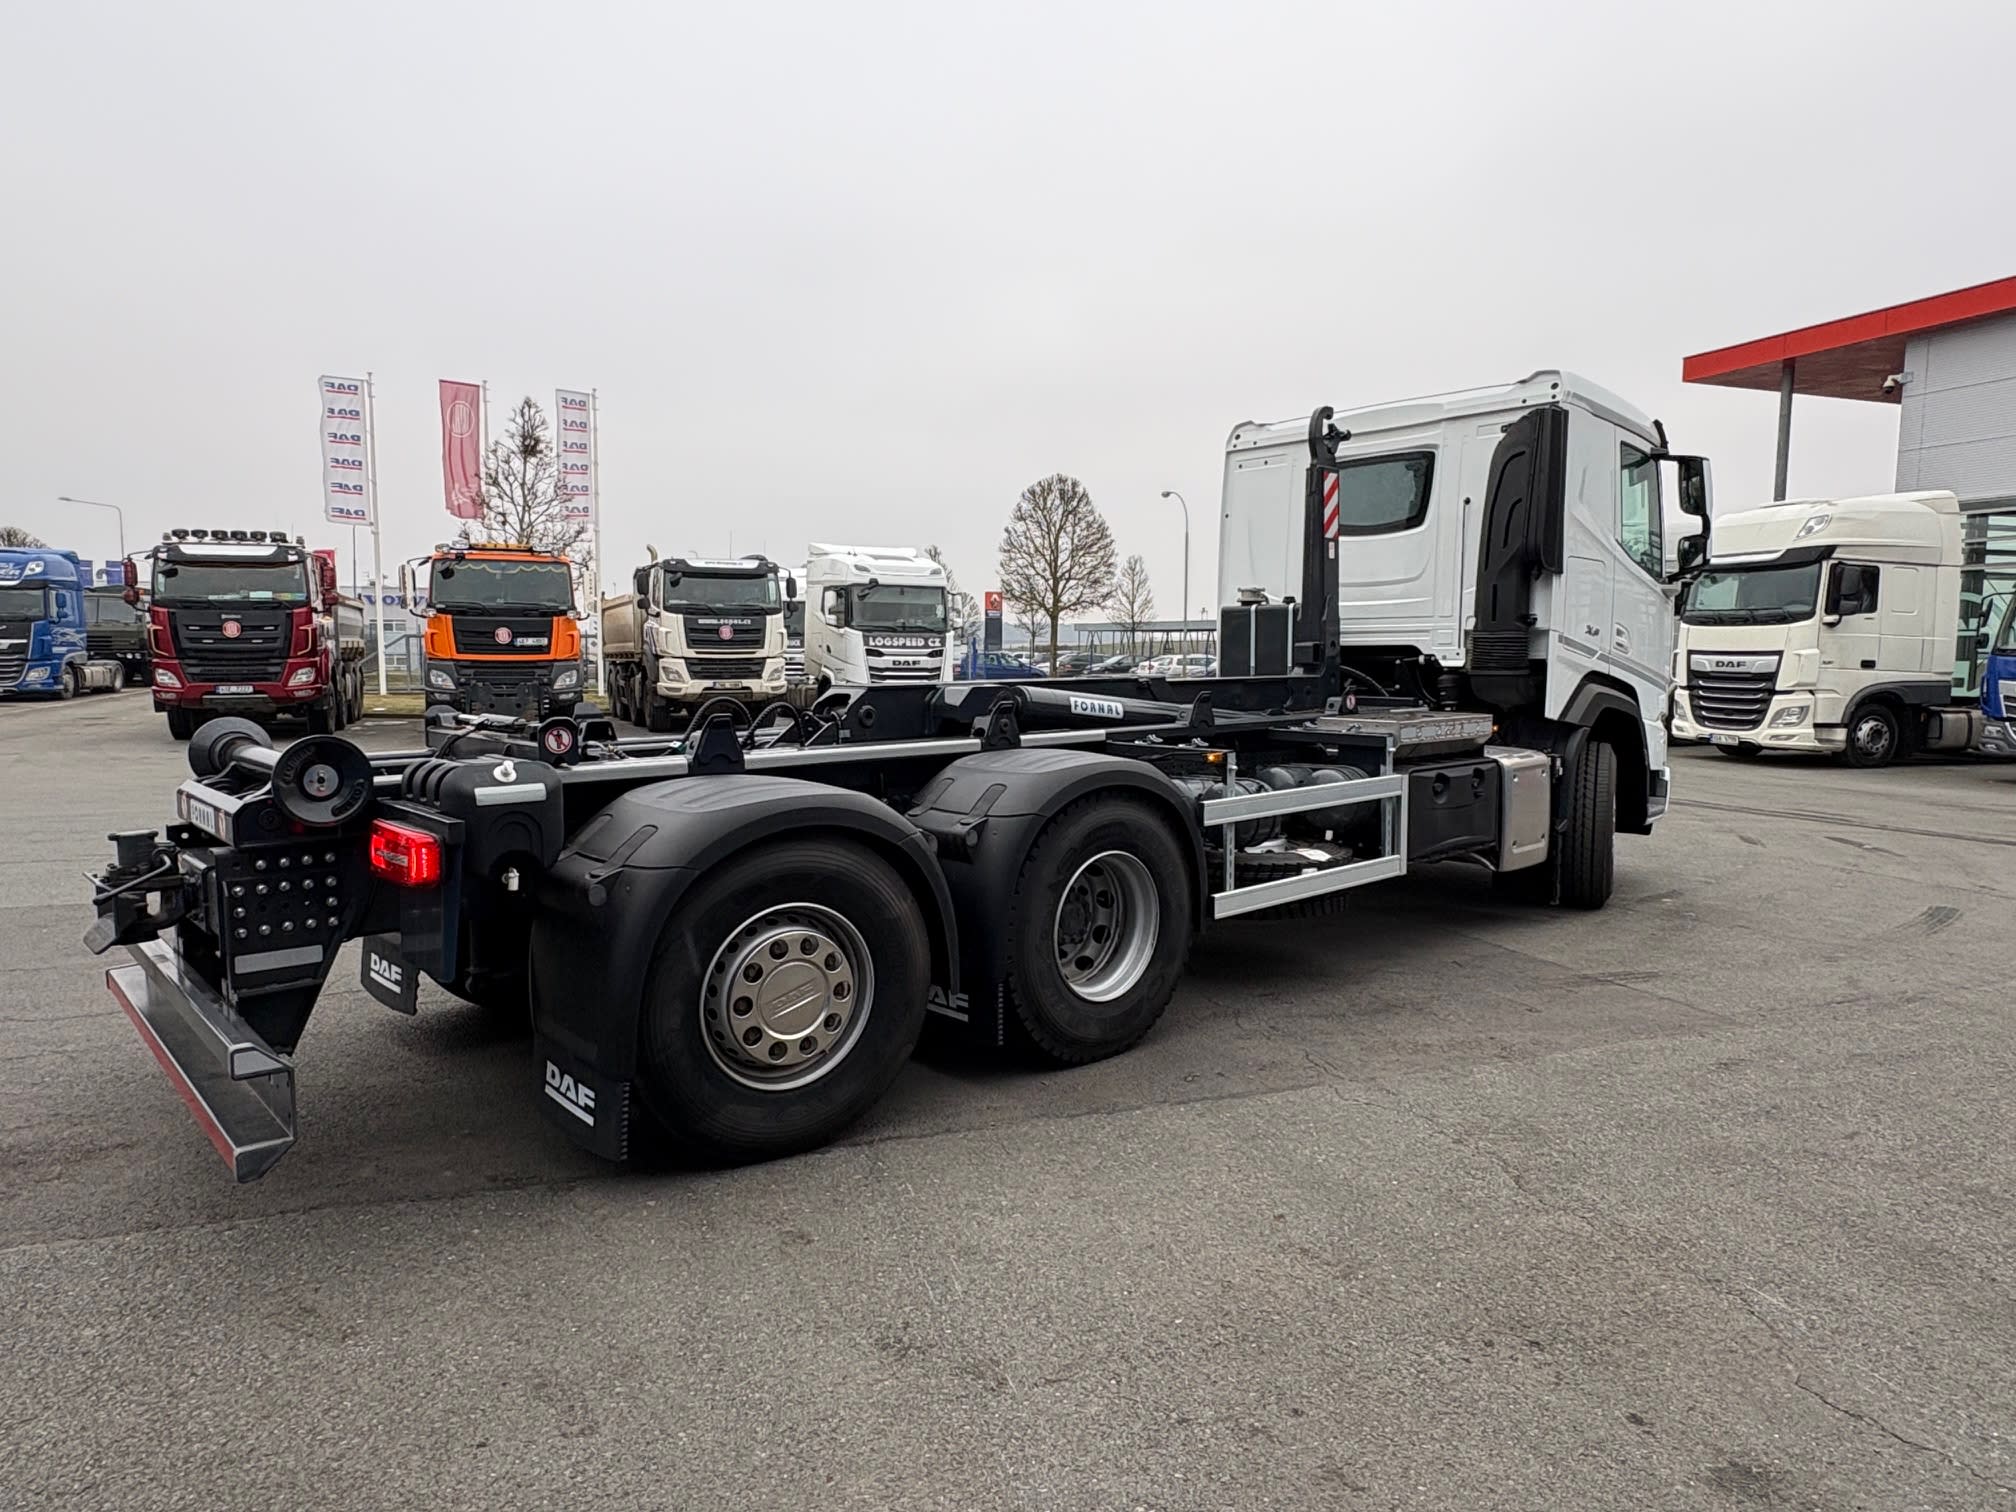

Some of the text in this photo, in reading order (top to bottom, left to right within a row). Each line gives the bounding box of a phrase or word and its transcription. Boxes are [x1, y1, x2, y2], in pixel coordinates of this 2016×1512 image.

[869, 637, 942, 647] LOGSPEED CZ
[1715, 660, 1747, 668] DAF
[1074, 700, 1121, 716] FORNAL
[370, 952, 402, 982] DAF
[928, 985, 969, 1009] AF
[546, 1060, 596, 1110] DAF
